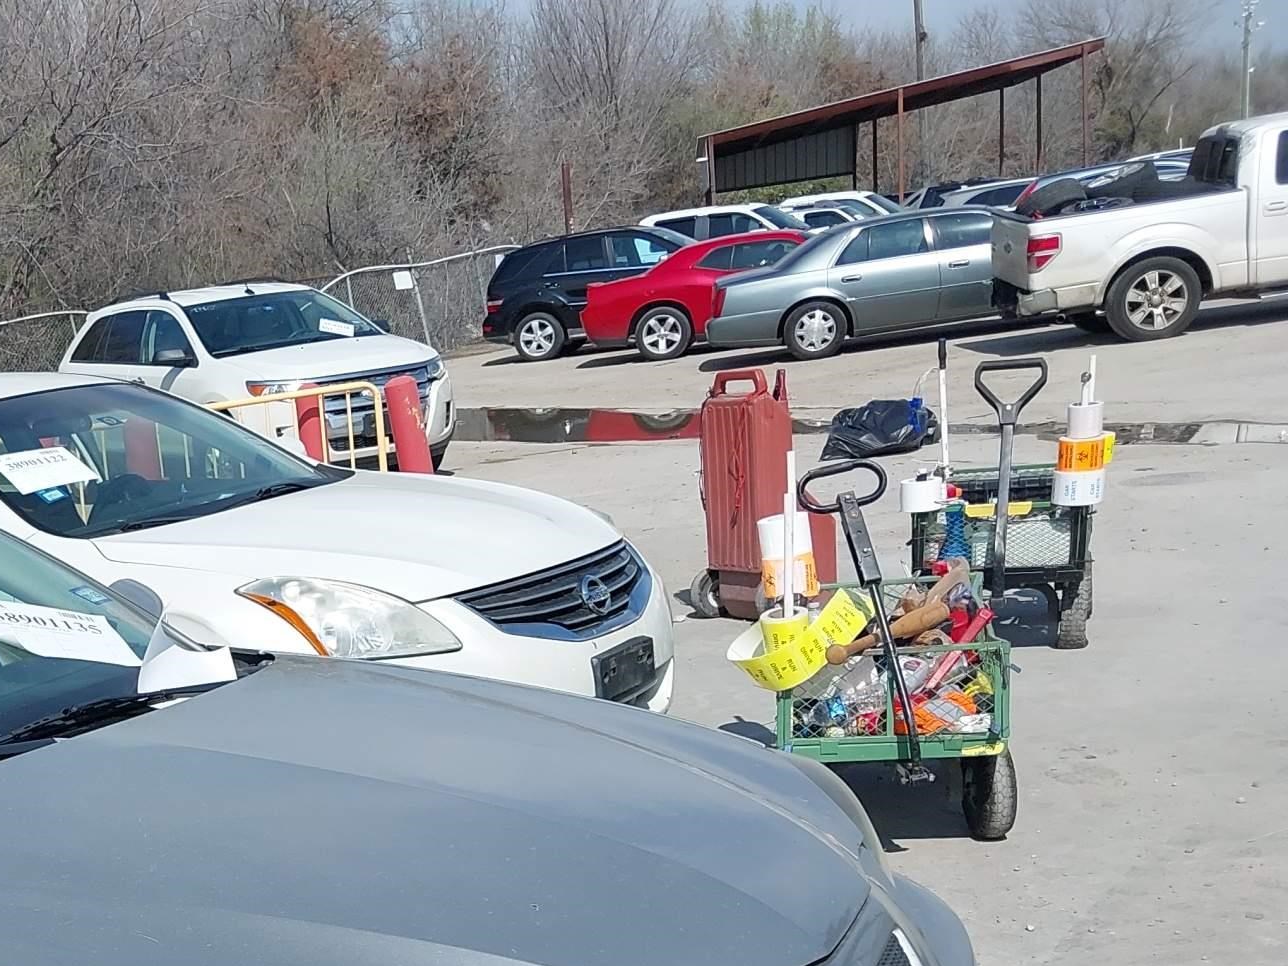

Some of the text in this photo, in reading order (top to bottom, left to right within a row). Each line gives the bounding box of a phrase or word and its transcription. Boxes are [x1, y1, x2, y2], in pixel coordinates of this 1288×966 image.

[5, 454, 68, 471] 38901122
[813, 638, 824, 653] RUN
[787, 658, 798, 672] RUN
